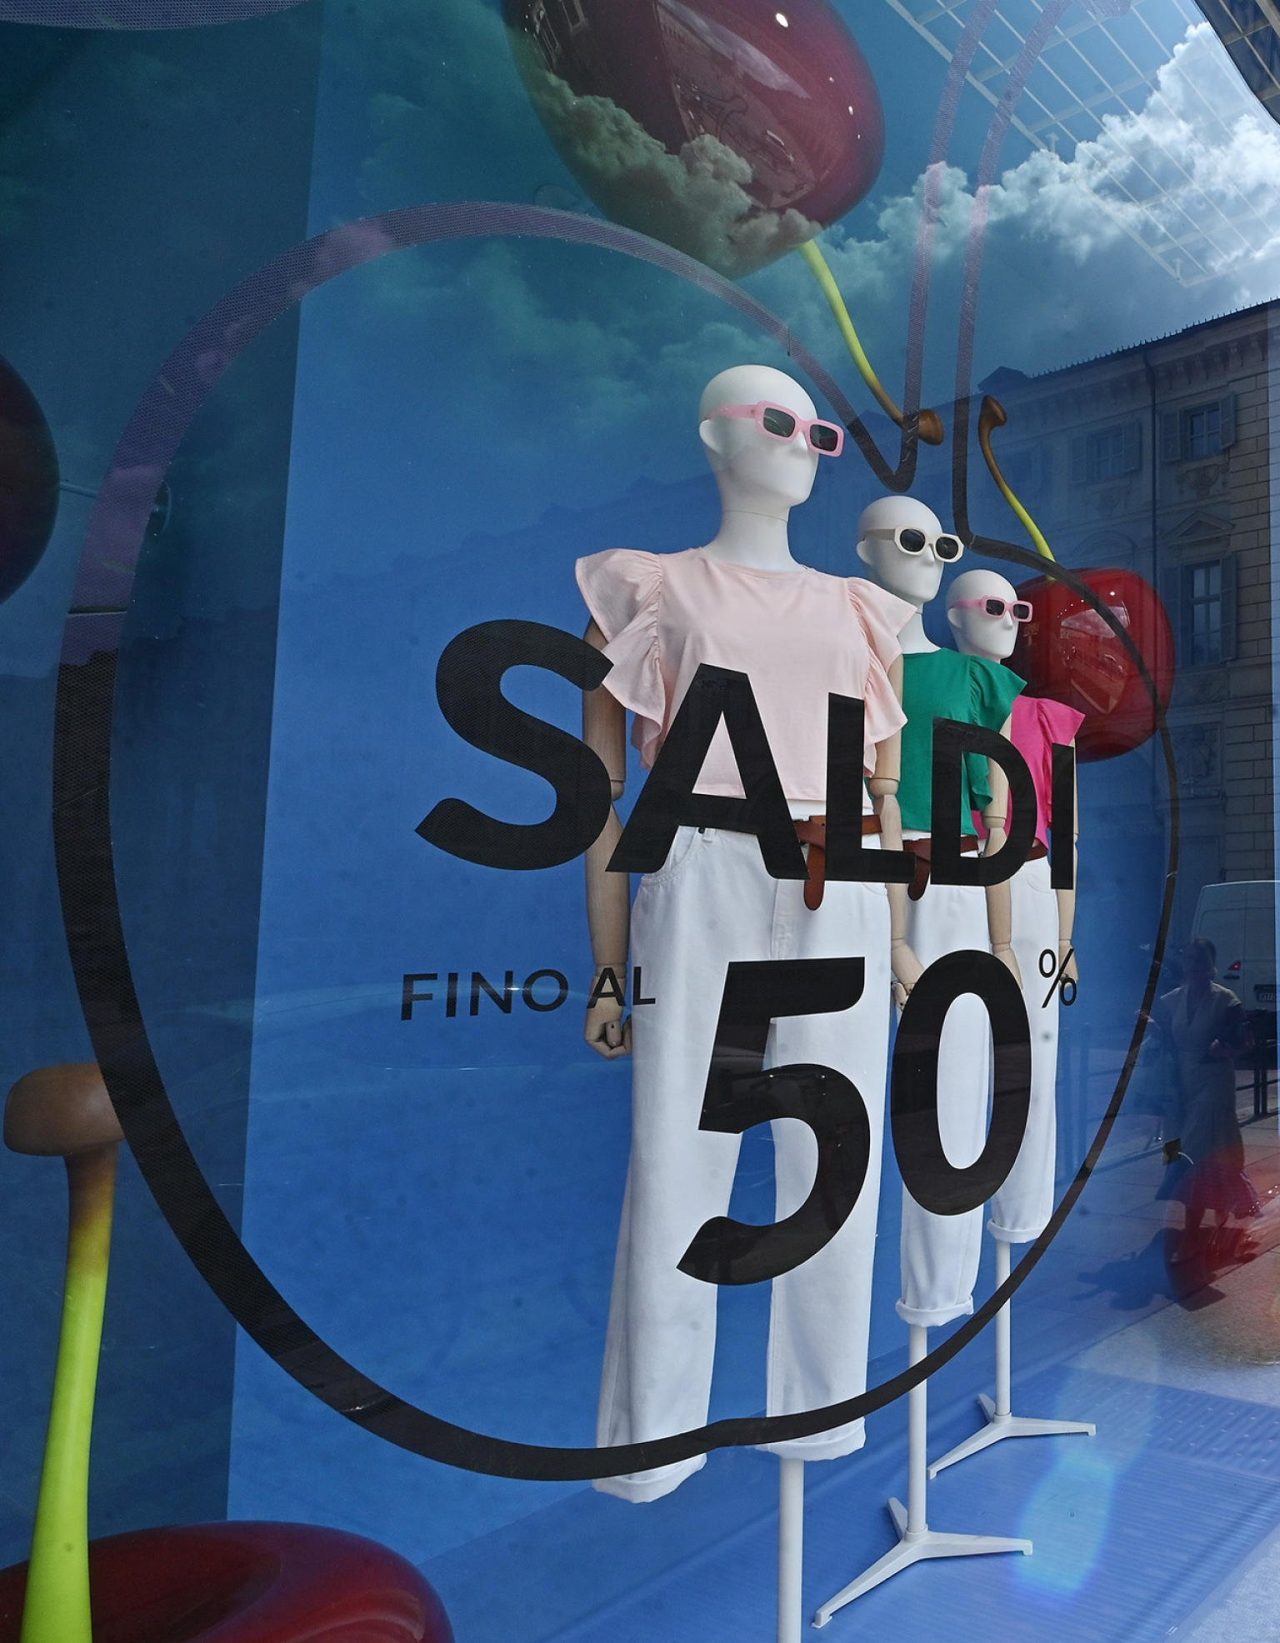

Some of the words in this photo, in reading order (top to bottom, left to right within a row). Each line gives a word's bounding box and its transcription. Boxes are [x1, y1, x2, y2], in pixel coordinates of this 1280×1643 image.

[414, 619, 1074, 890] SALDI
[401, 969, 569, 1020] FINO
[586, 966, 656, 1009] AL
